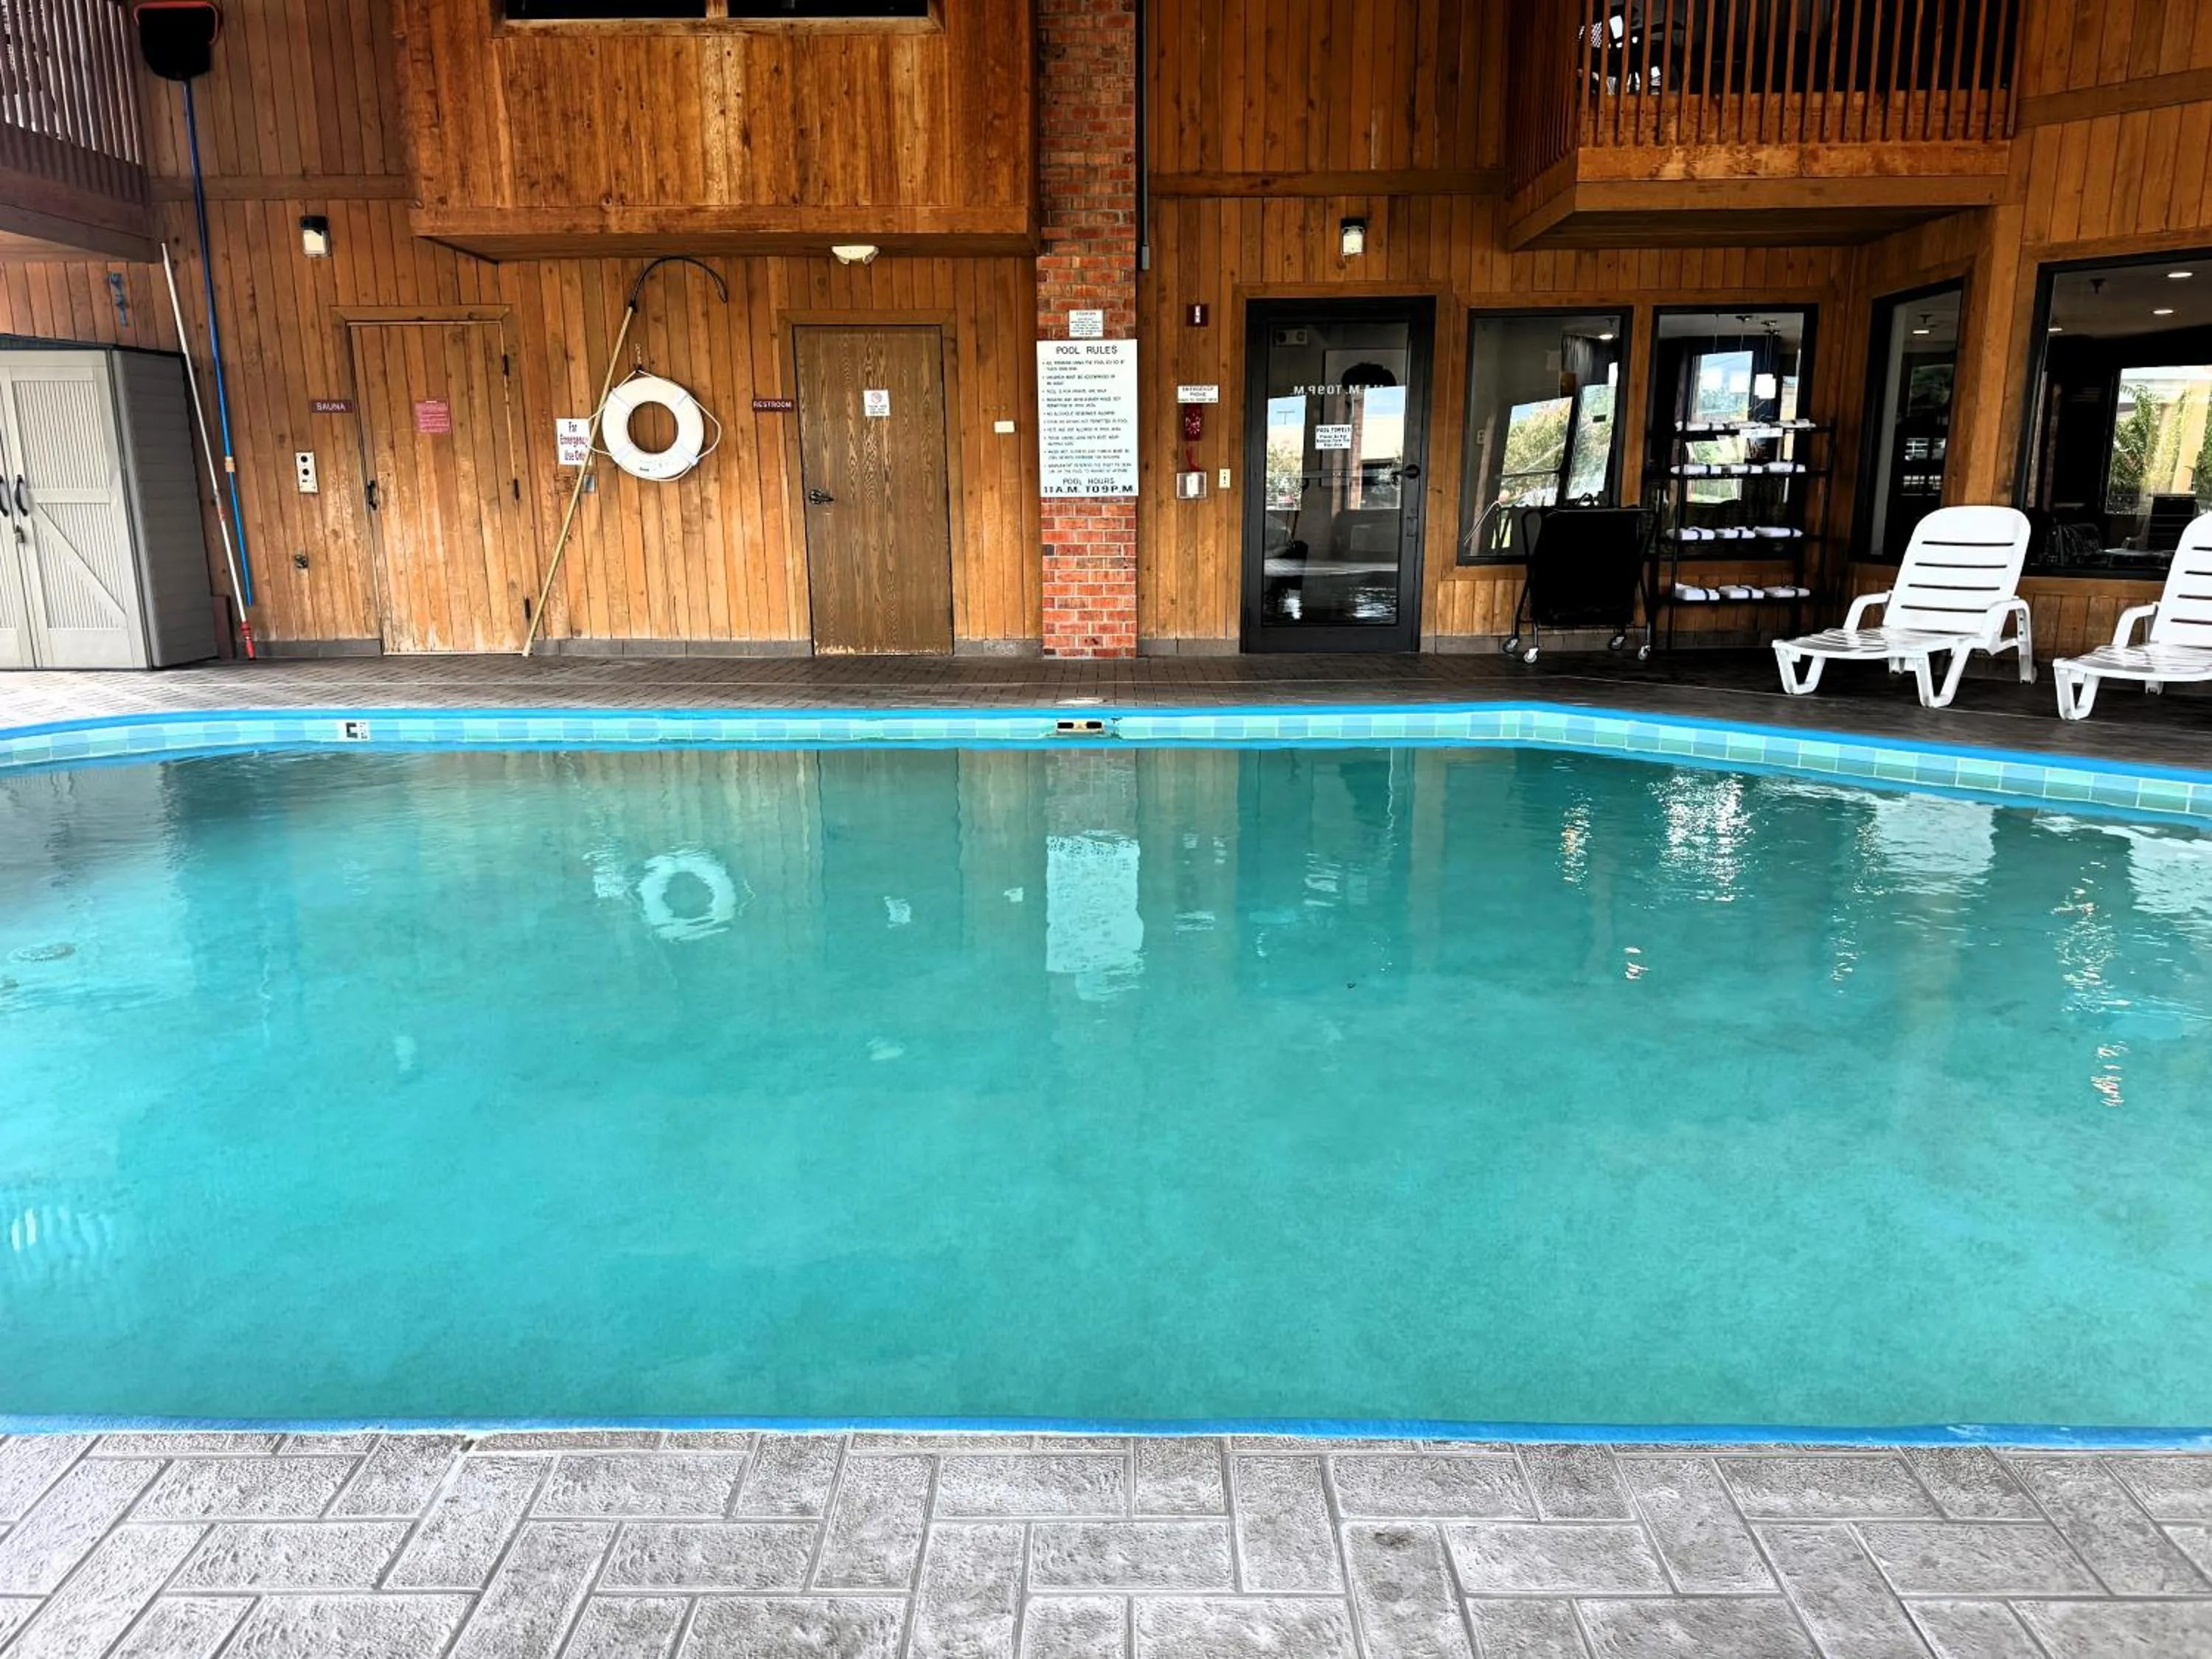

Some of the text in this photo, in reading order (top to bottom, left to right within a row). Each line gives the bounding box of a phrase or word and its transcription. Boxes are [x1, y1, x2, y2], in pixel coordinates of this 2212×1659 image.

[1055, 345, 1118, 355] POOL RULES
[316, 402, 346, 411] SAUNA
[568, 421, 577, 433] For
[560, 434, 588, 448] Emergency
[564, 449, 574, 461] Use
[1062, 477, 1116, 485] POOL HOURS
